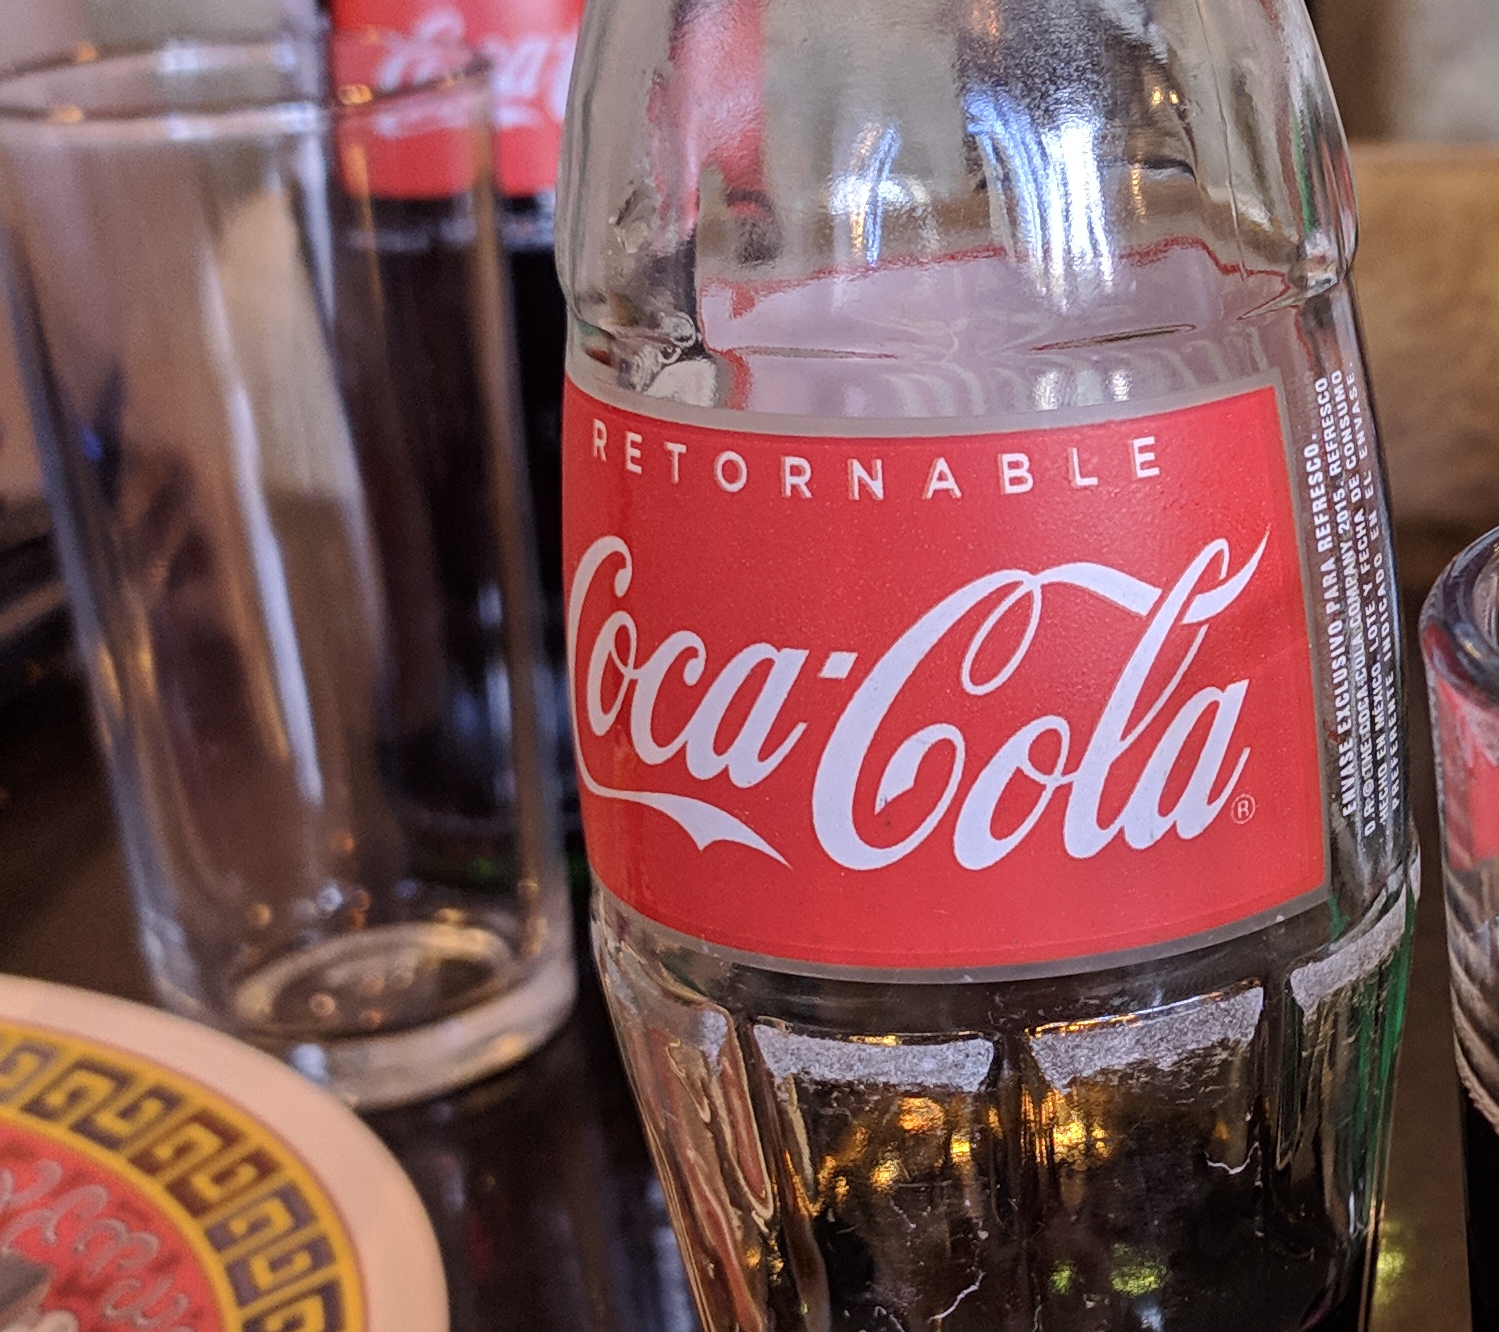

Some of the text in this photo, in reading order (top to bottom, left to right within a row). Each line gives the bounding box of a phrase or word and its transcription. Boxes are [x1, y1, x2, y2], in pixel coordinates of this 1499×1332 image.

[1315, 377, 1342, 476] REFRESCO
[1331, 370, 1357, 470] CONSUMO
[589, 418, 1162, 501] RETORNABLE
[1348, 474, 1362, 504] DE
[1363, 470, 1375, 500] EL
[1332, 480, 1350, 534] 2015.
[1368, 509, 1379, 541] EN
[1354, 508, 1371, 574] FECHA
[1340, 540, 1362, 628] COMPANY
[1362, 582, 1373, 597] Y
[1373, 552, 1392, 662] INDICADO
[1303, 433, 1357, 817] ENVASE EXCLUSIVO PARA REFRESCO.
[1365, 601, 1379, 652] LOTE
[567, 530, 1271, 873] Coca-Cola
[1375, 732, 1387, 760] EN
[1385, 671, 1400, 810] PREFERENTE
[1377, 762, 1389, 823] HECHO
